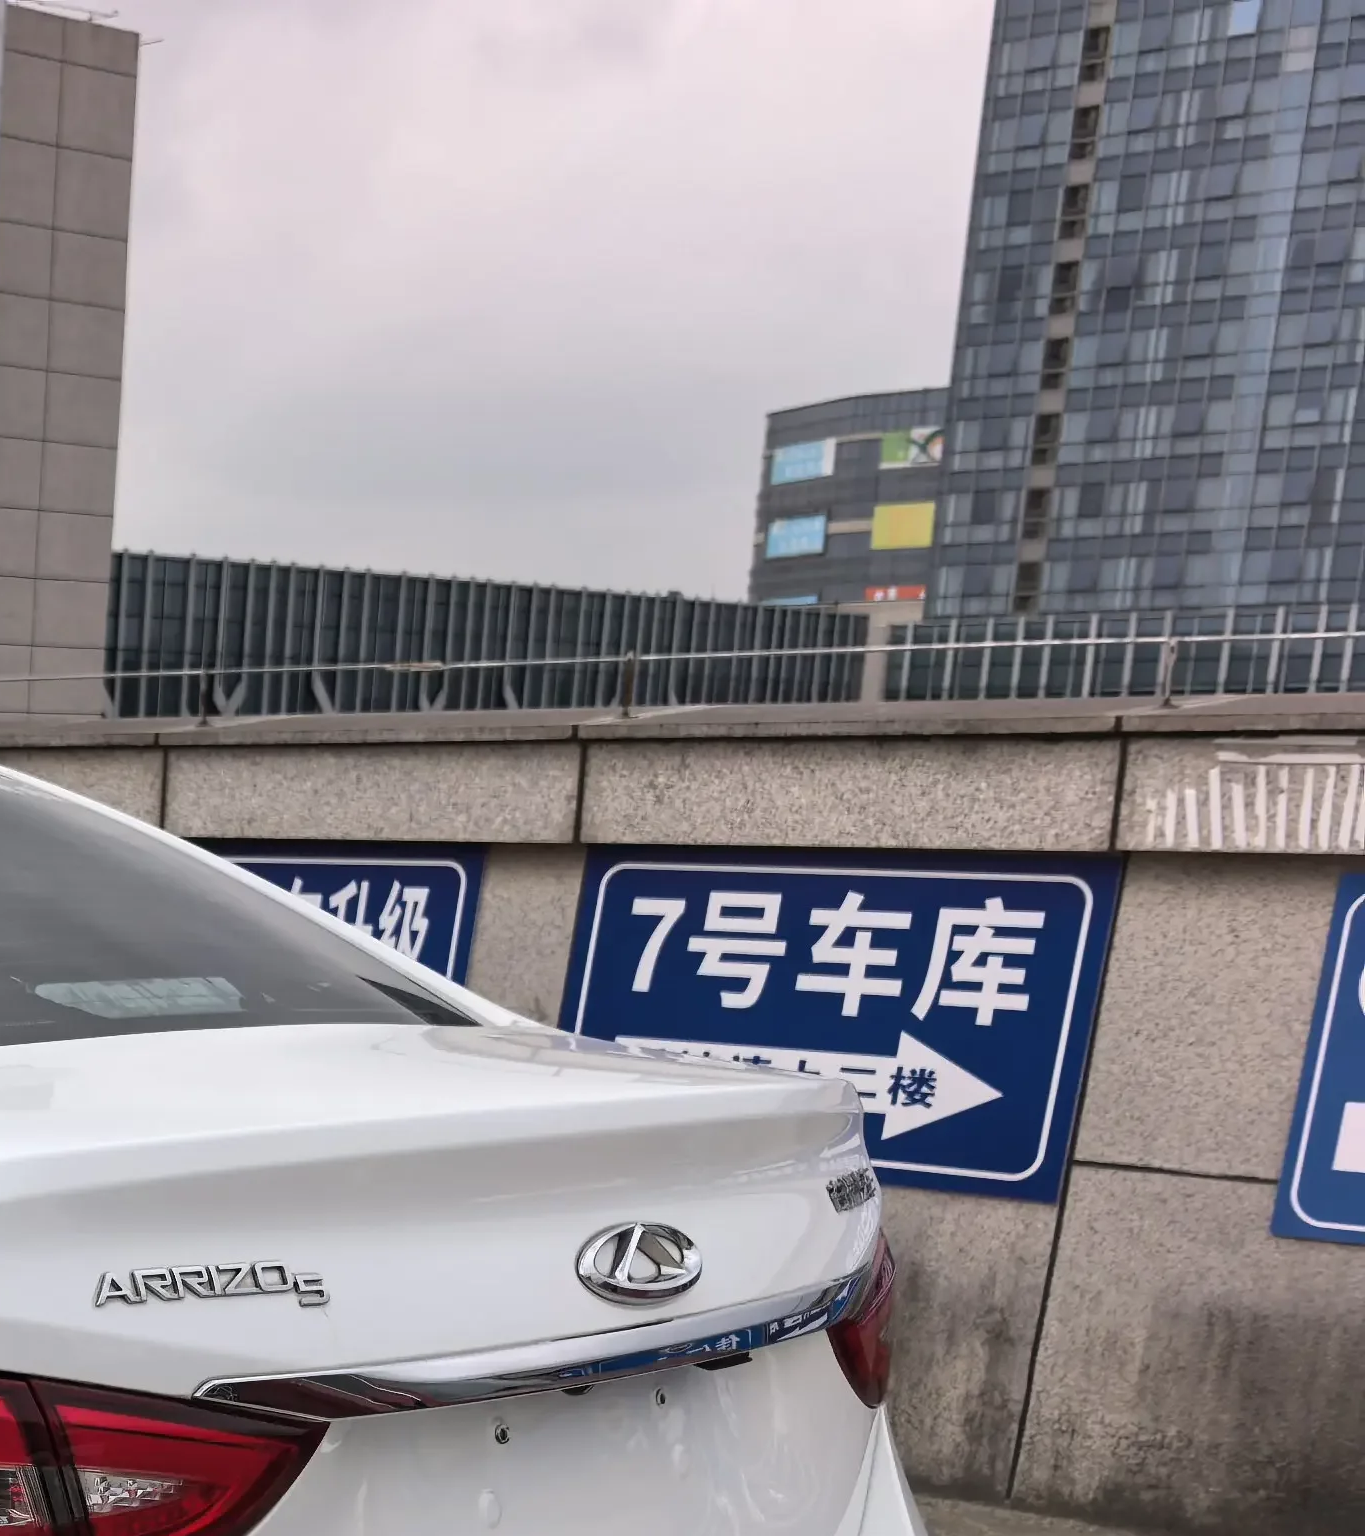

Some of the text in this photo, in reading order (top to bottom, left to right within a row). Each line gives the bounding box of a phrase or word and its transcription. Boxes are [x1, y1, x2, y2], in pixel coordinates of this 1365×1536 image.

[290, 876, 430, 962] 升级
[630, 889, 1046, 1027] 7号车库
